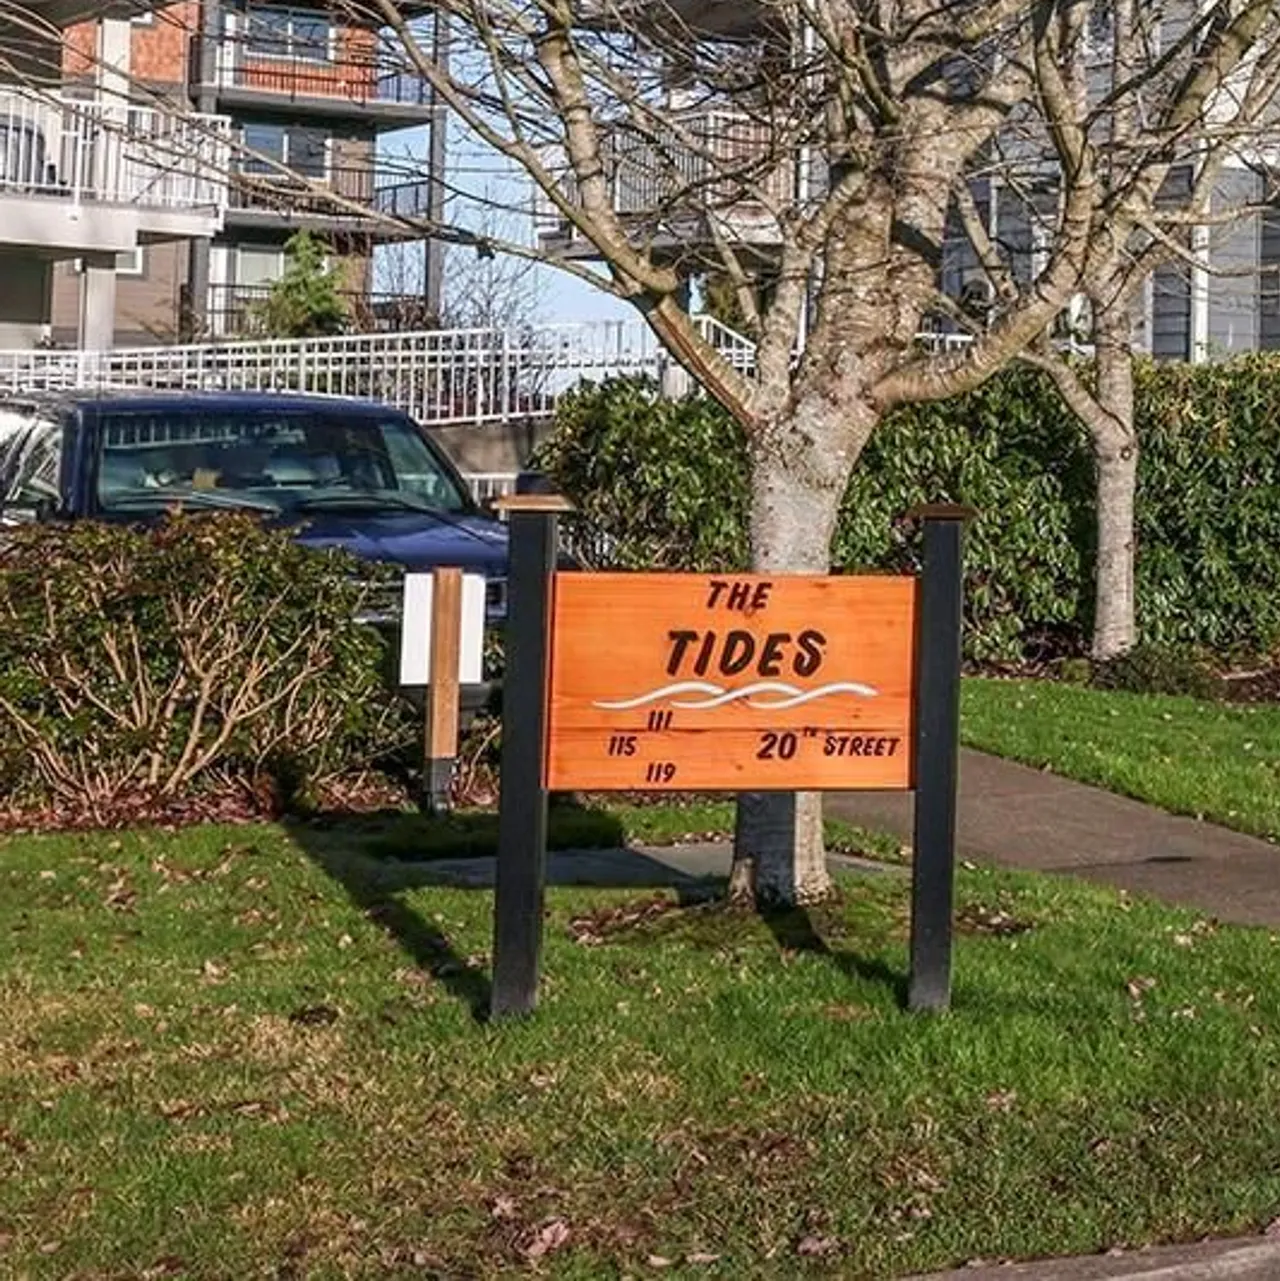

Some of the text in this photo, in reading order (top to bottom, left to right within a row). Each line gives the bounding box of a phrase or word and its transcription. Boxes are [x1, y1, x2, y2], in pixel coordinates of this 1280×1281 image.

[706, 580, 773, 611] THE
[666, 630, 828, 677] TIDES
[647, 709, 673, 733] 111
[608, 736, 638, 757] 115
[823, 735, 901, 757] STREET
[646, 762, 677, 783] 119
